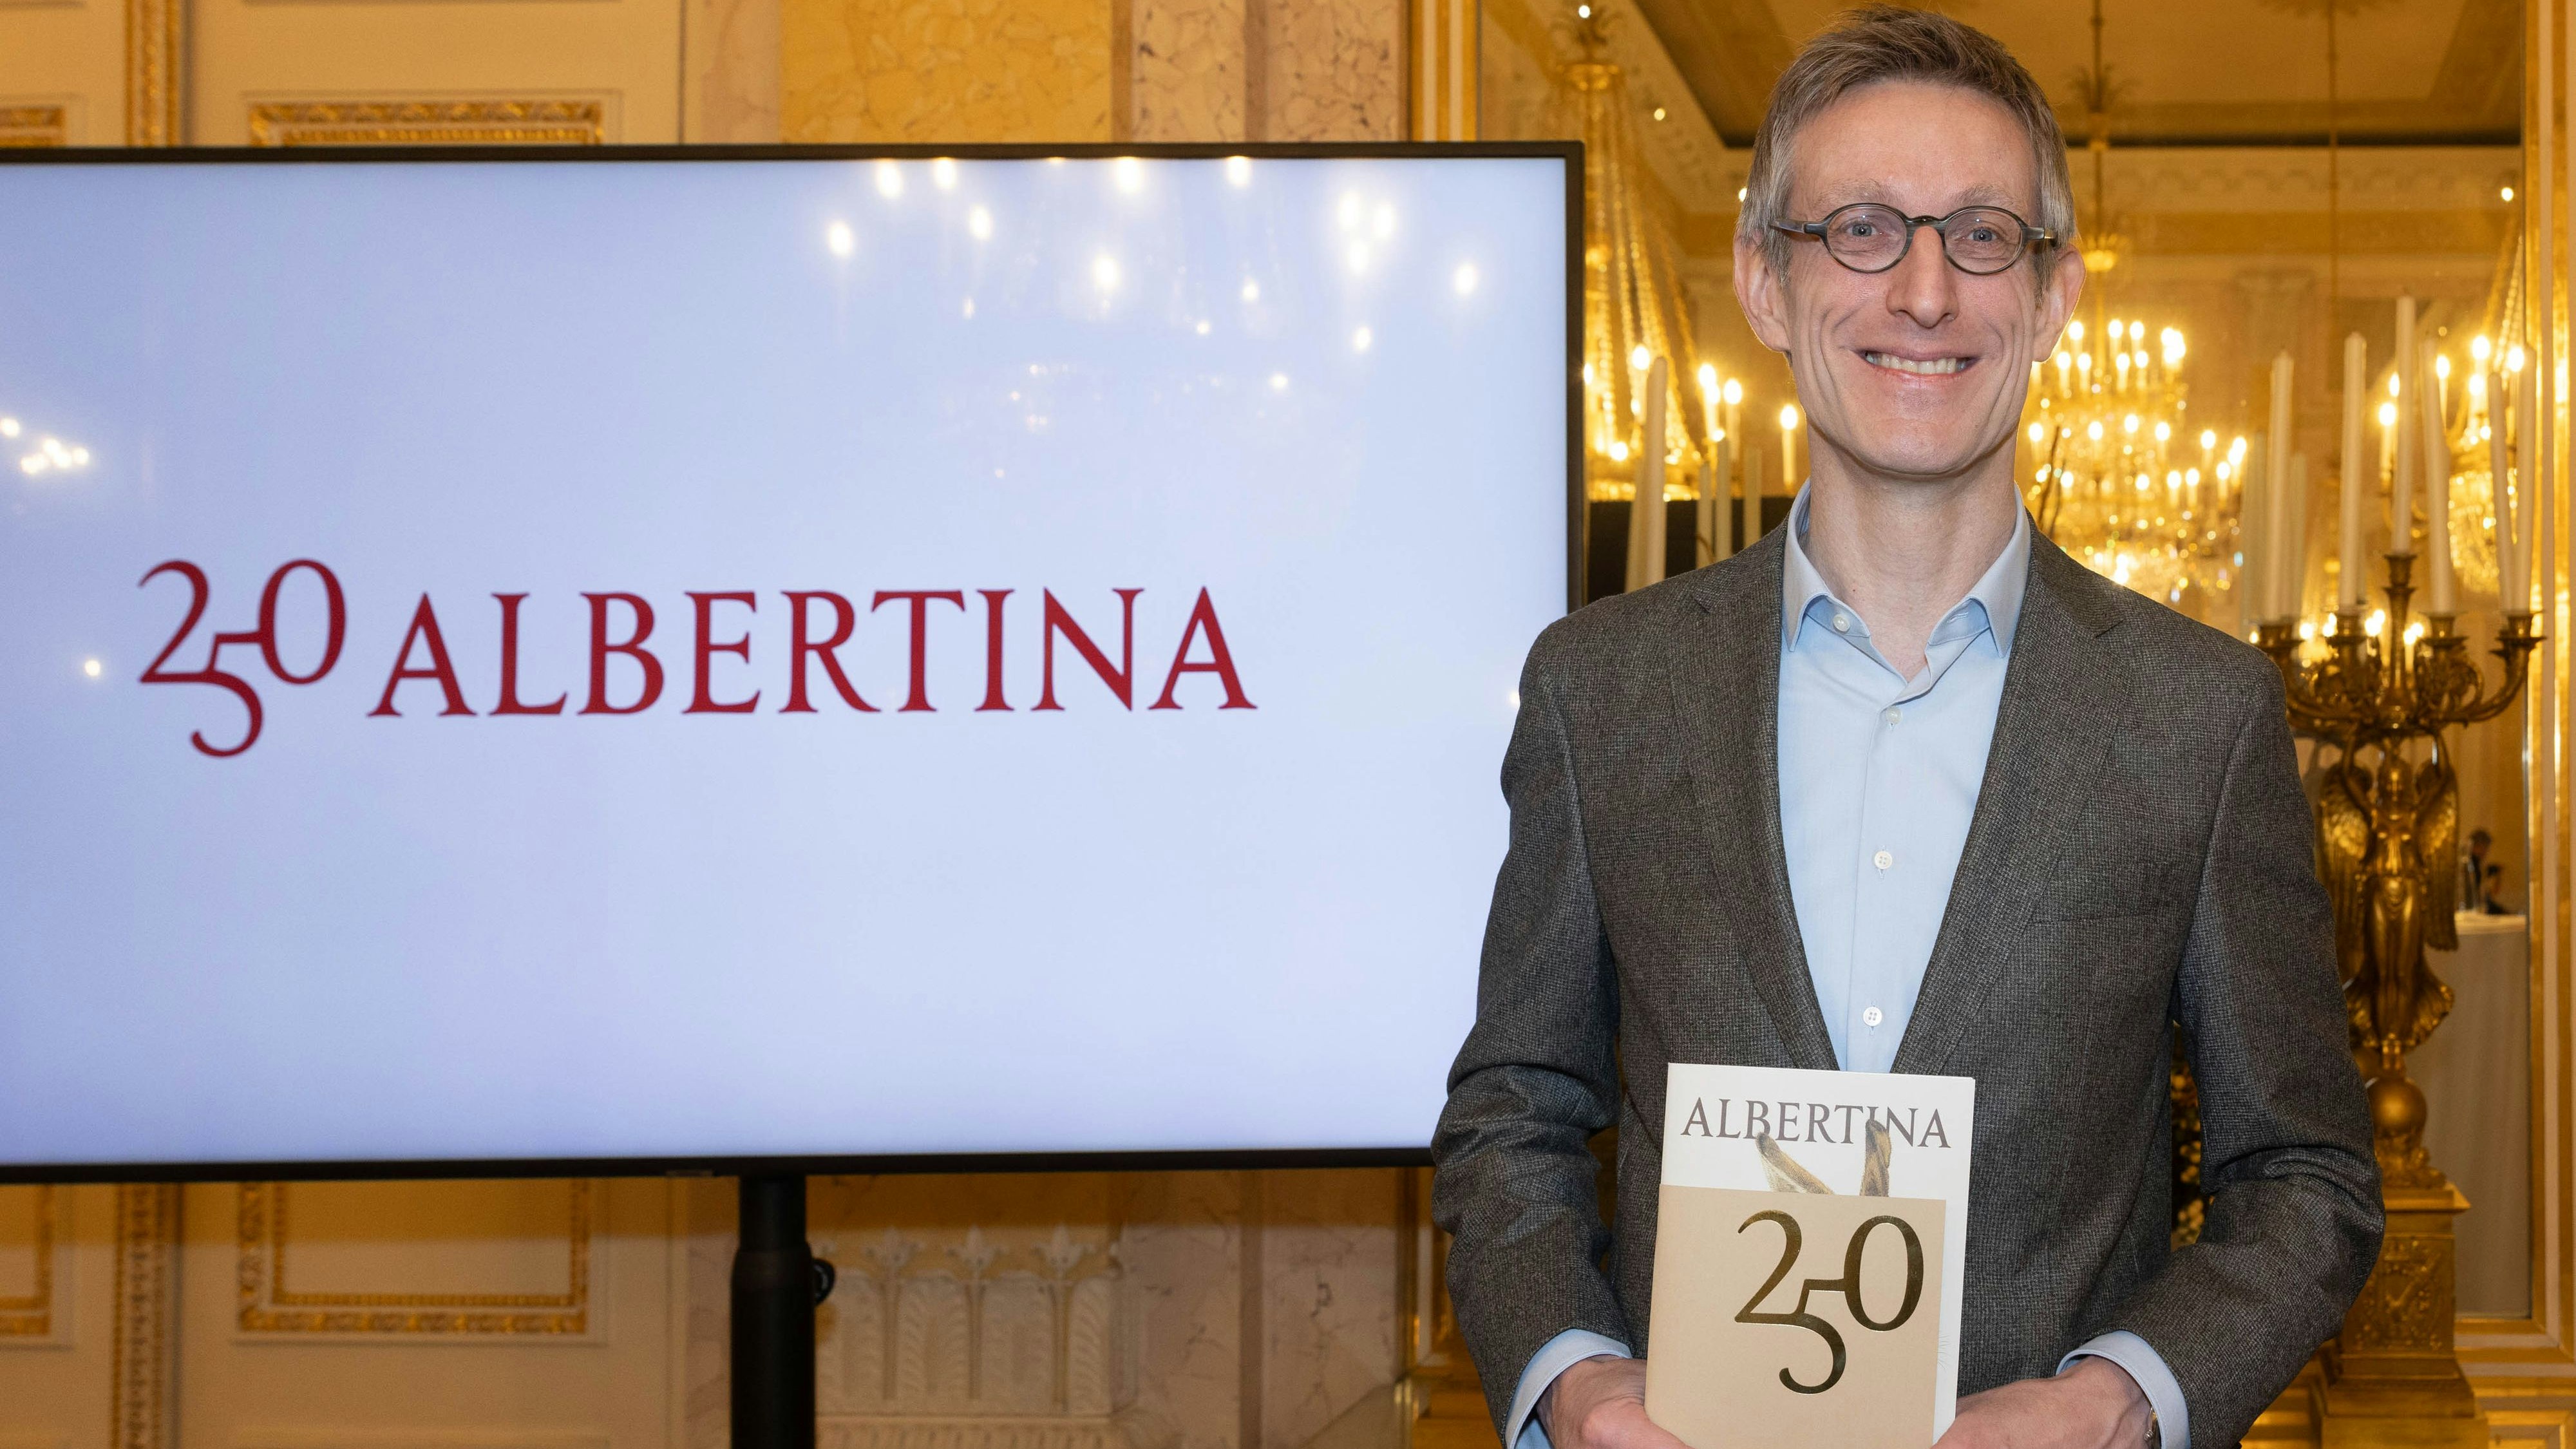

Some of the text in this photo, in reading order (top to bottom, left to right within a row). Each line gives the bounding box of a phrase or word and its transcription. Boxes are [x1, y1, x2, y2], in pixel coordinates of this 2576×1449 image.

[138, 559, 1258, 758] 250 ALBERTINA
[1734, 1209, 1924, 1395] 250
